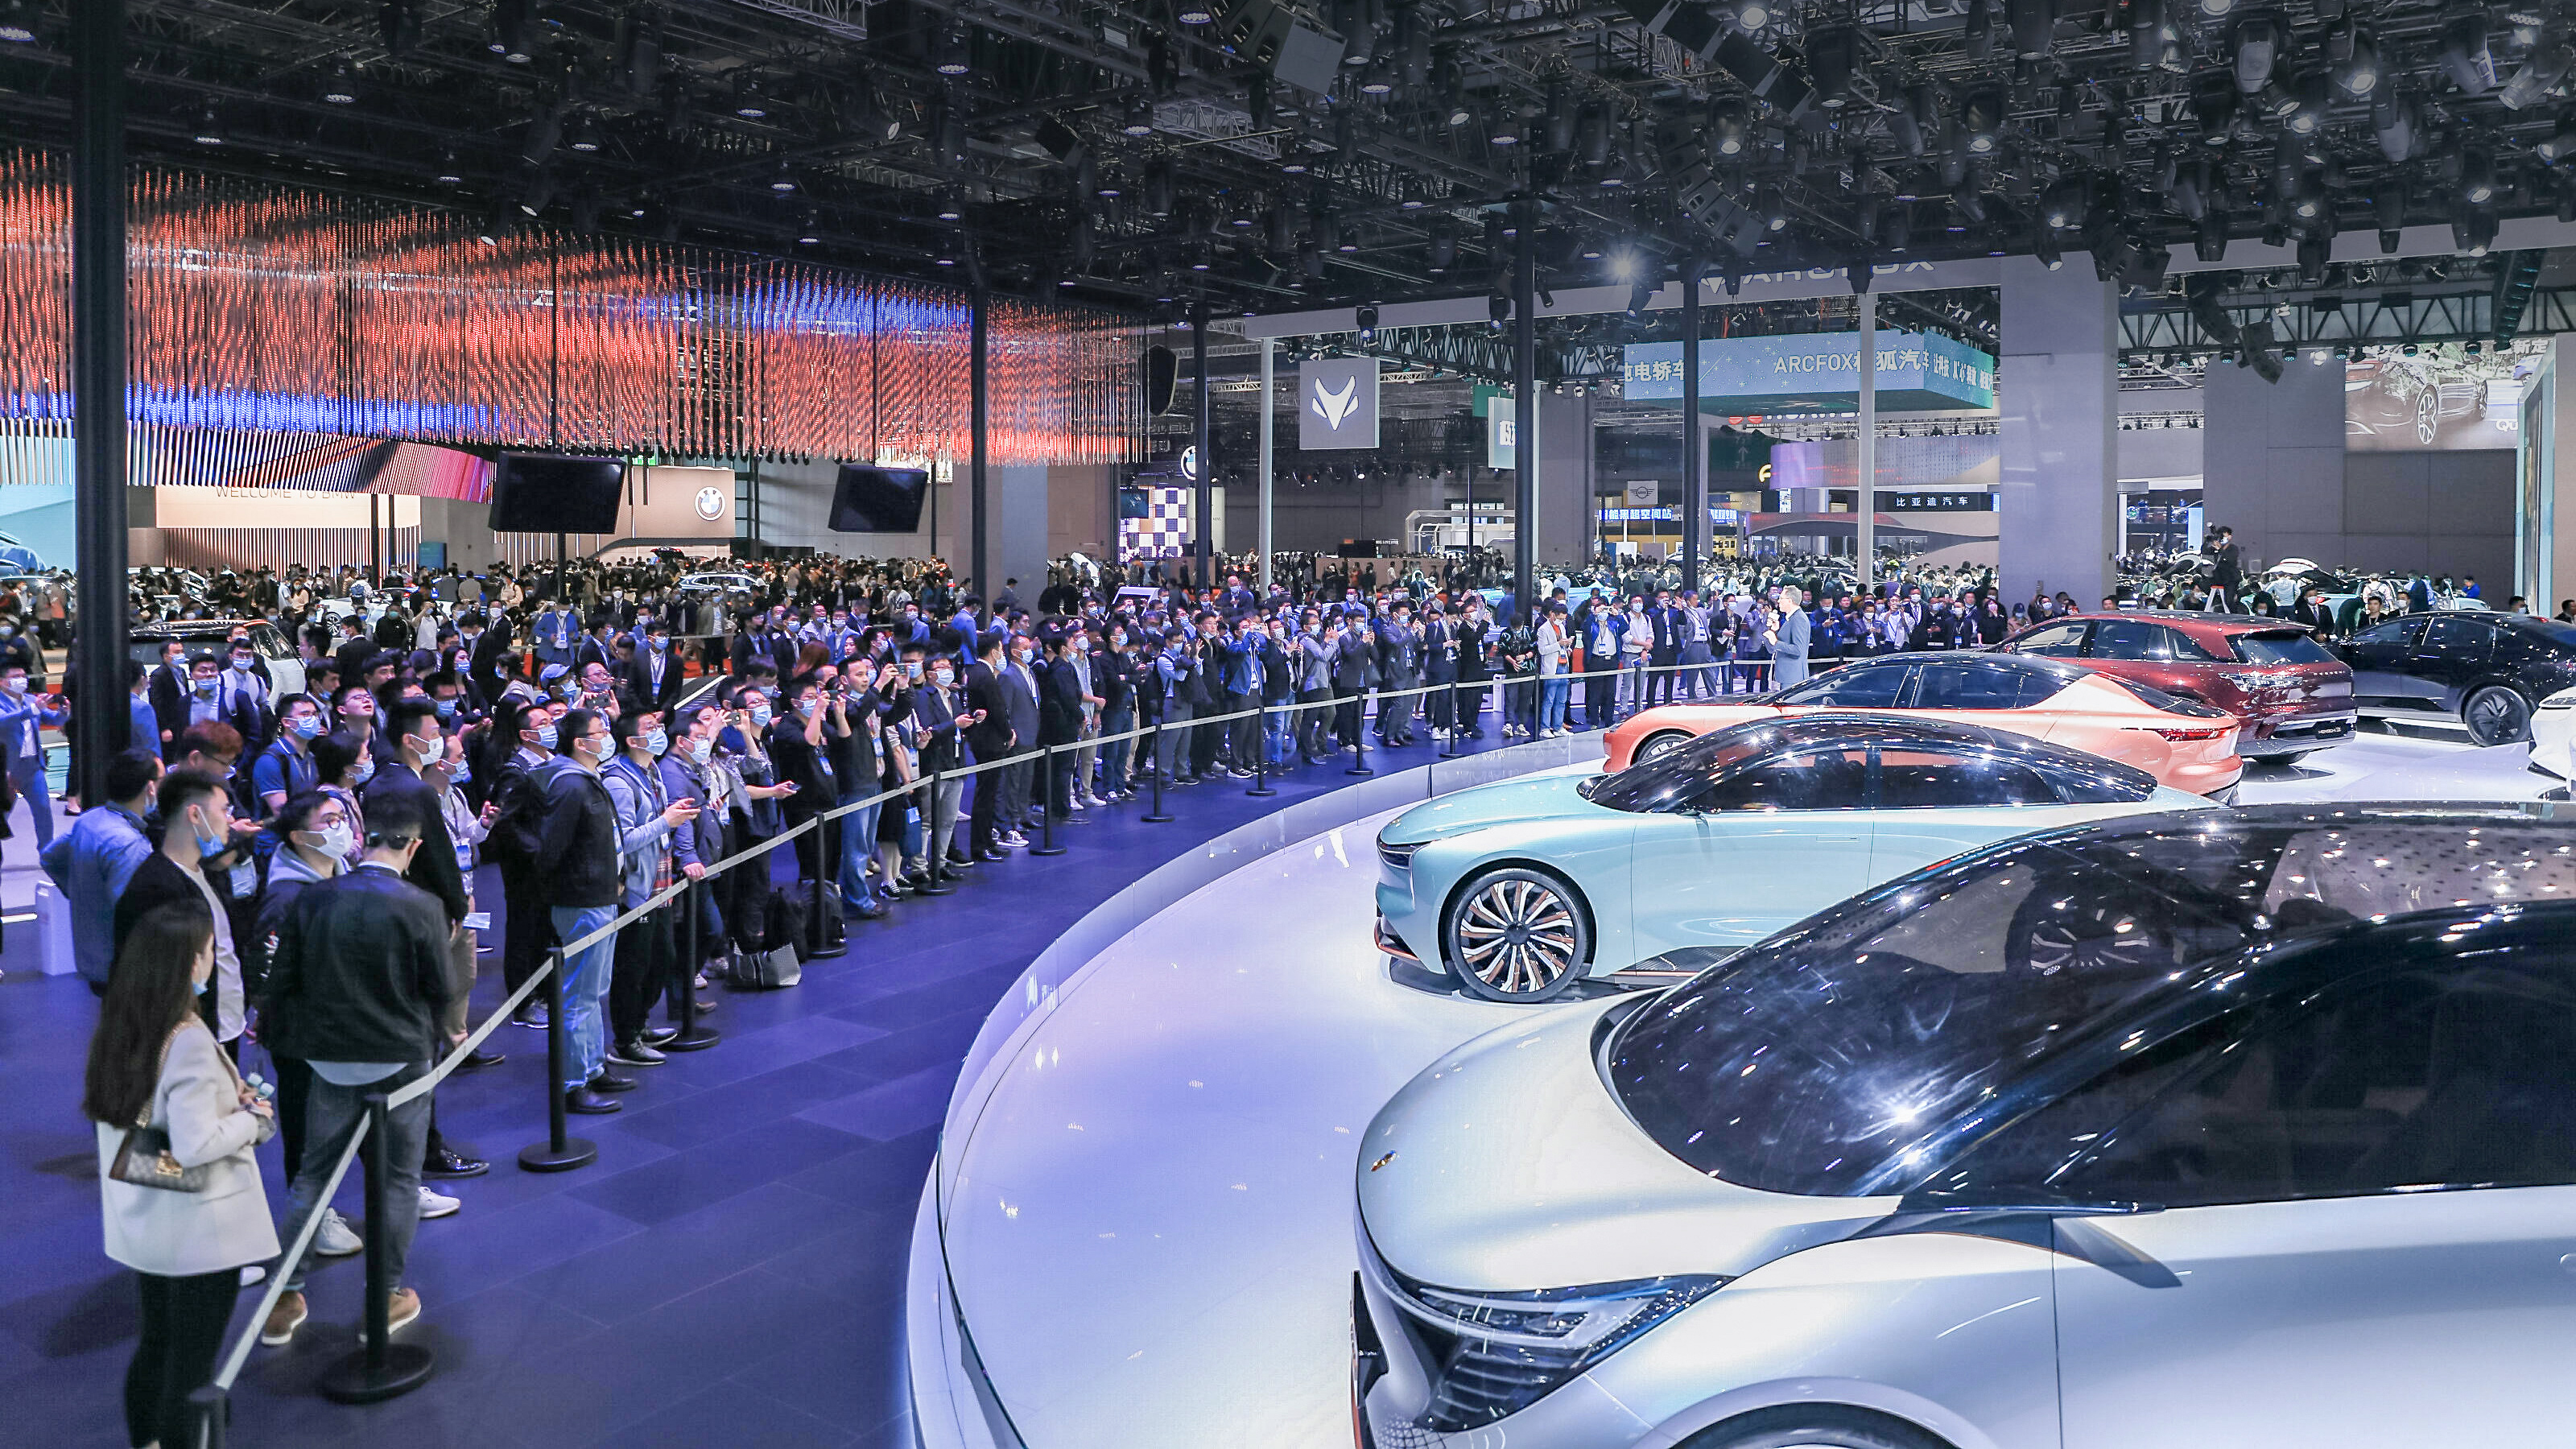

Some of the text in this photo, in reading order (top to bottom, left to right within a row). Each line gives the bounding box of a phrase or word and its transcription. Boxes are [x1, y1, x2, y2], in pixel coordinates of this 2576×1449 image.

[1896, 496, 1968, 507] 比亚迪汽车
